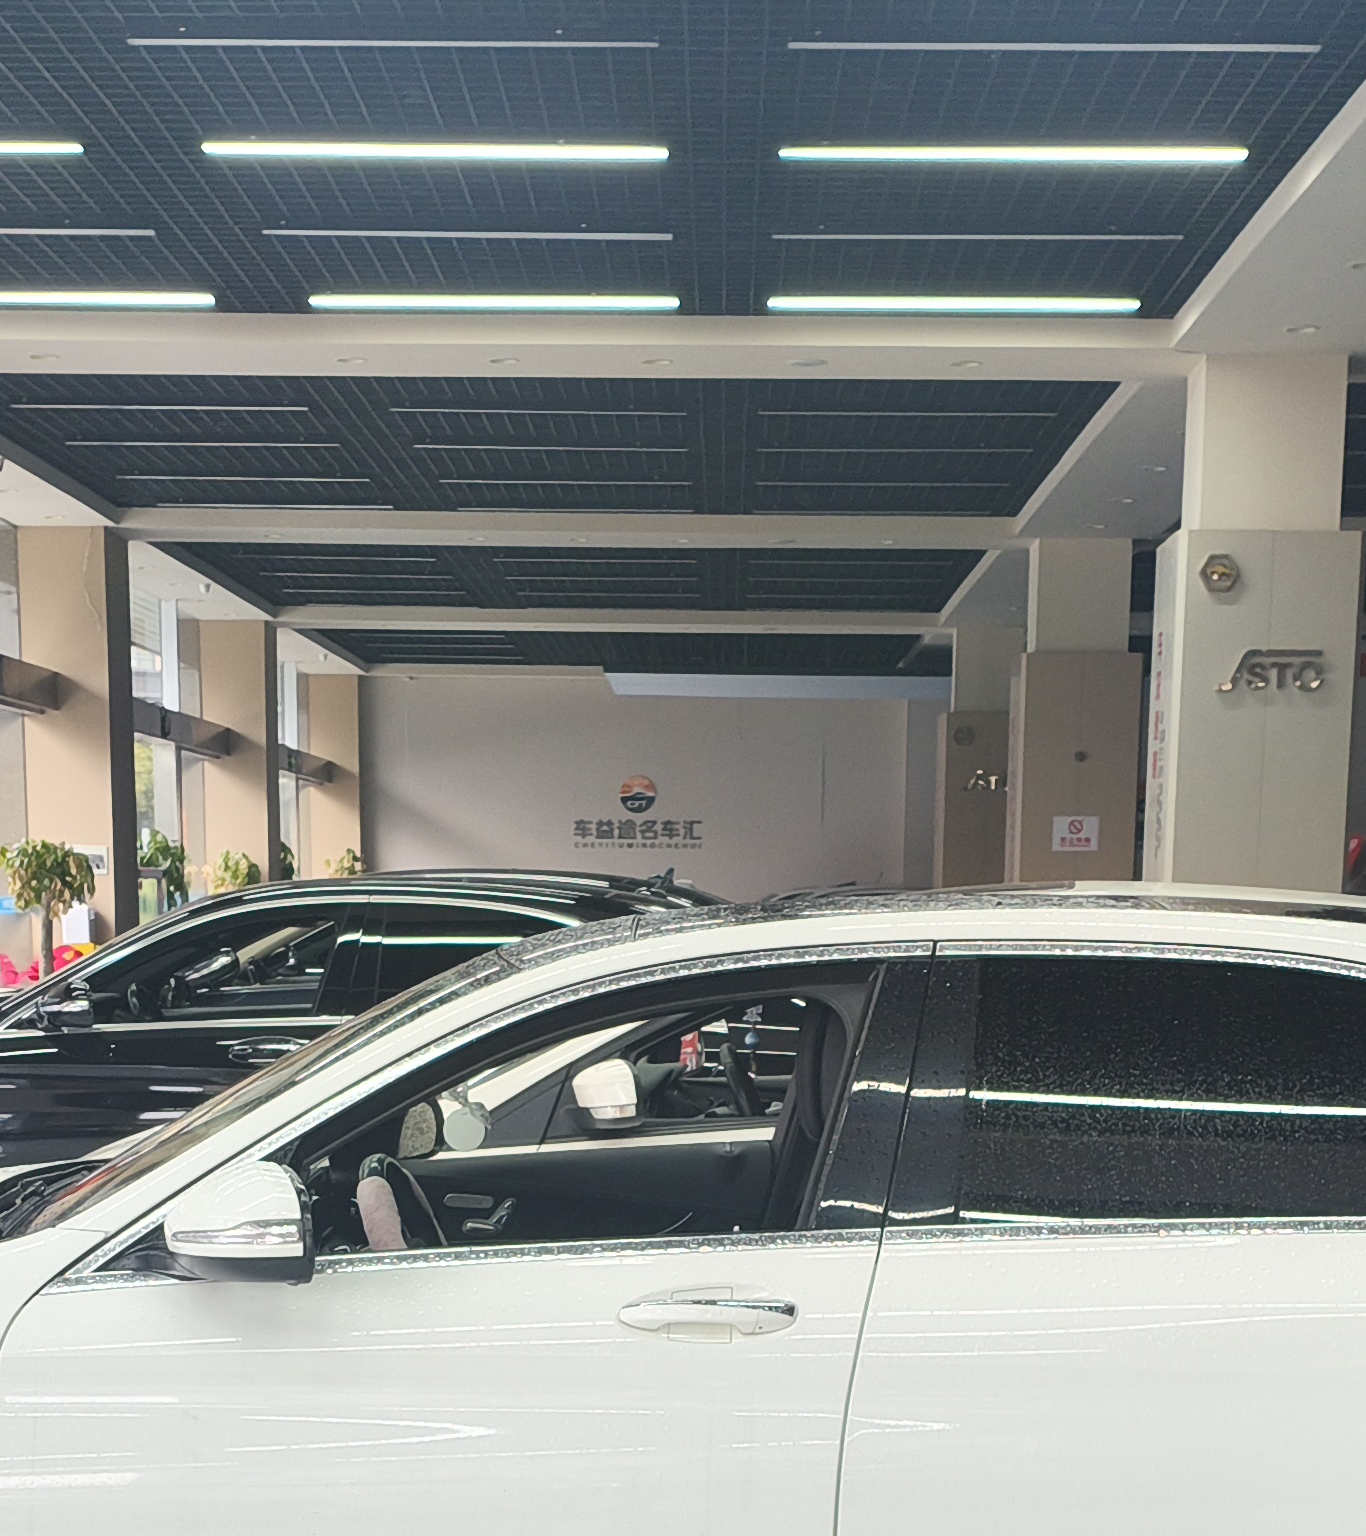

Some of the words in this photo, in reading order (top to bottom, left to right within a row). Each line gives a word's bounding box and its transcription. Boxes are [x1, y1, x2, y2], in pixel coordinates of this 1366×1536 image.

[573, 819, 703, 840] 车益途名车汇
